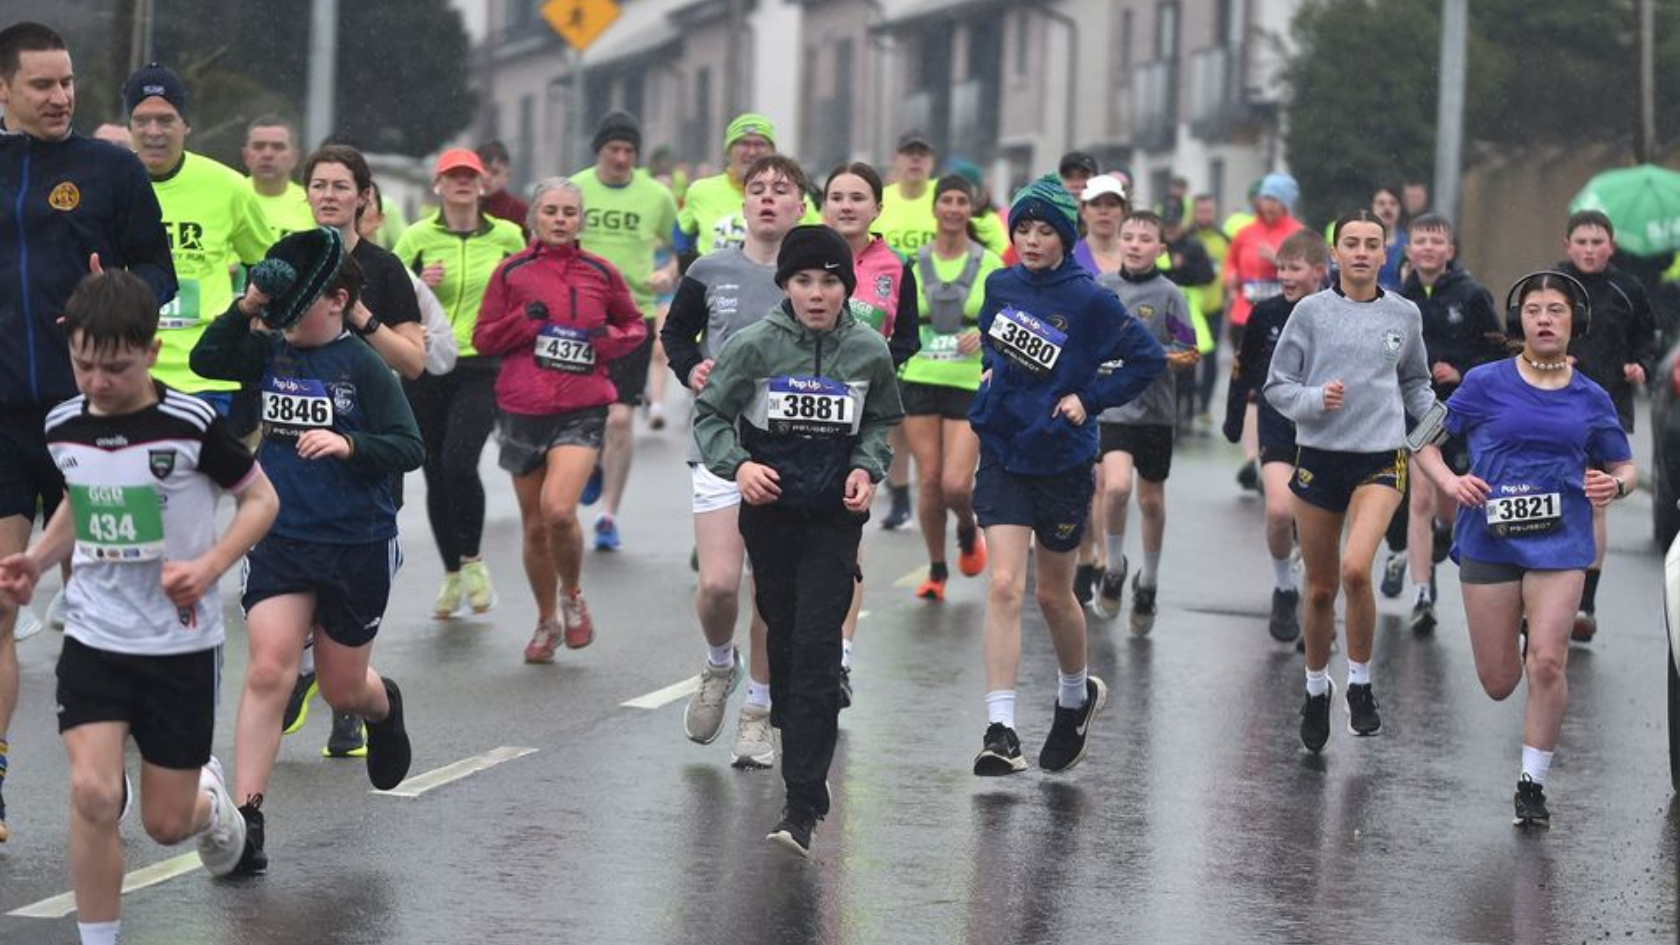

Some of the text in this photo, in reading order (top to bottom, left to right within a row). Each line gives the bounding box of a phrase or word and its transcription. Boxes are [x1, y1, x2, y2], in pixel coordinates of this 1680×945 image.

[547, 339, 593, 361] 4374
[1002, 322, 1056, 364] 3880
[789, 377, 822, 391] Pop Up
[267, 395, 328, 424] 3846
[783, 394, 845, 421] 3881
[1501, 483, 1531, 494] Pop Up
[1499, 494, 1554, 520] 3821
[89, 513, 138, 541] 434
